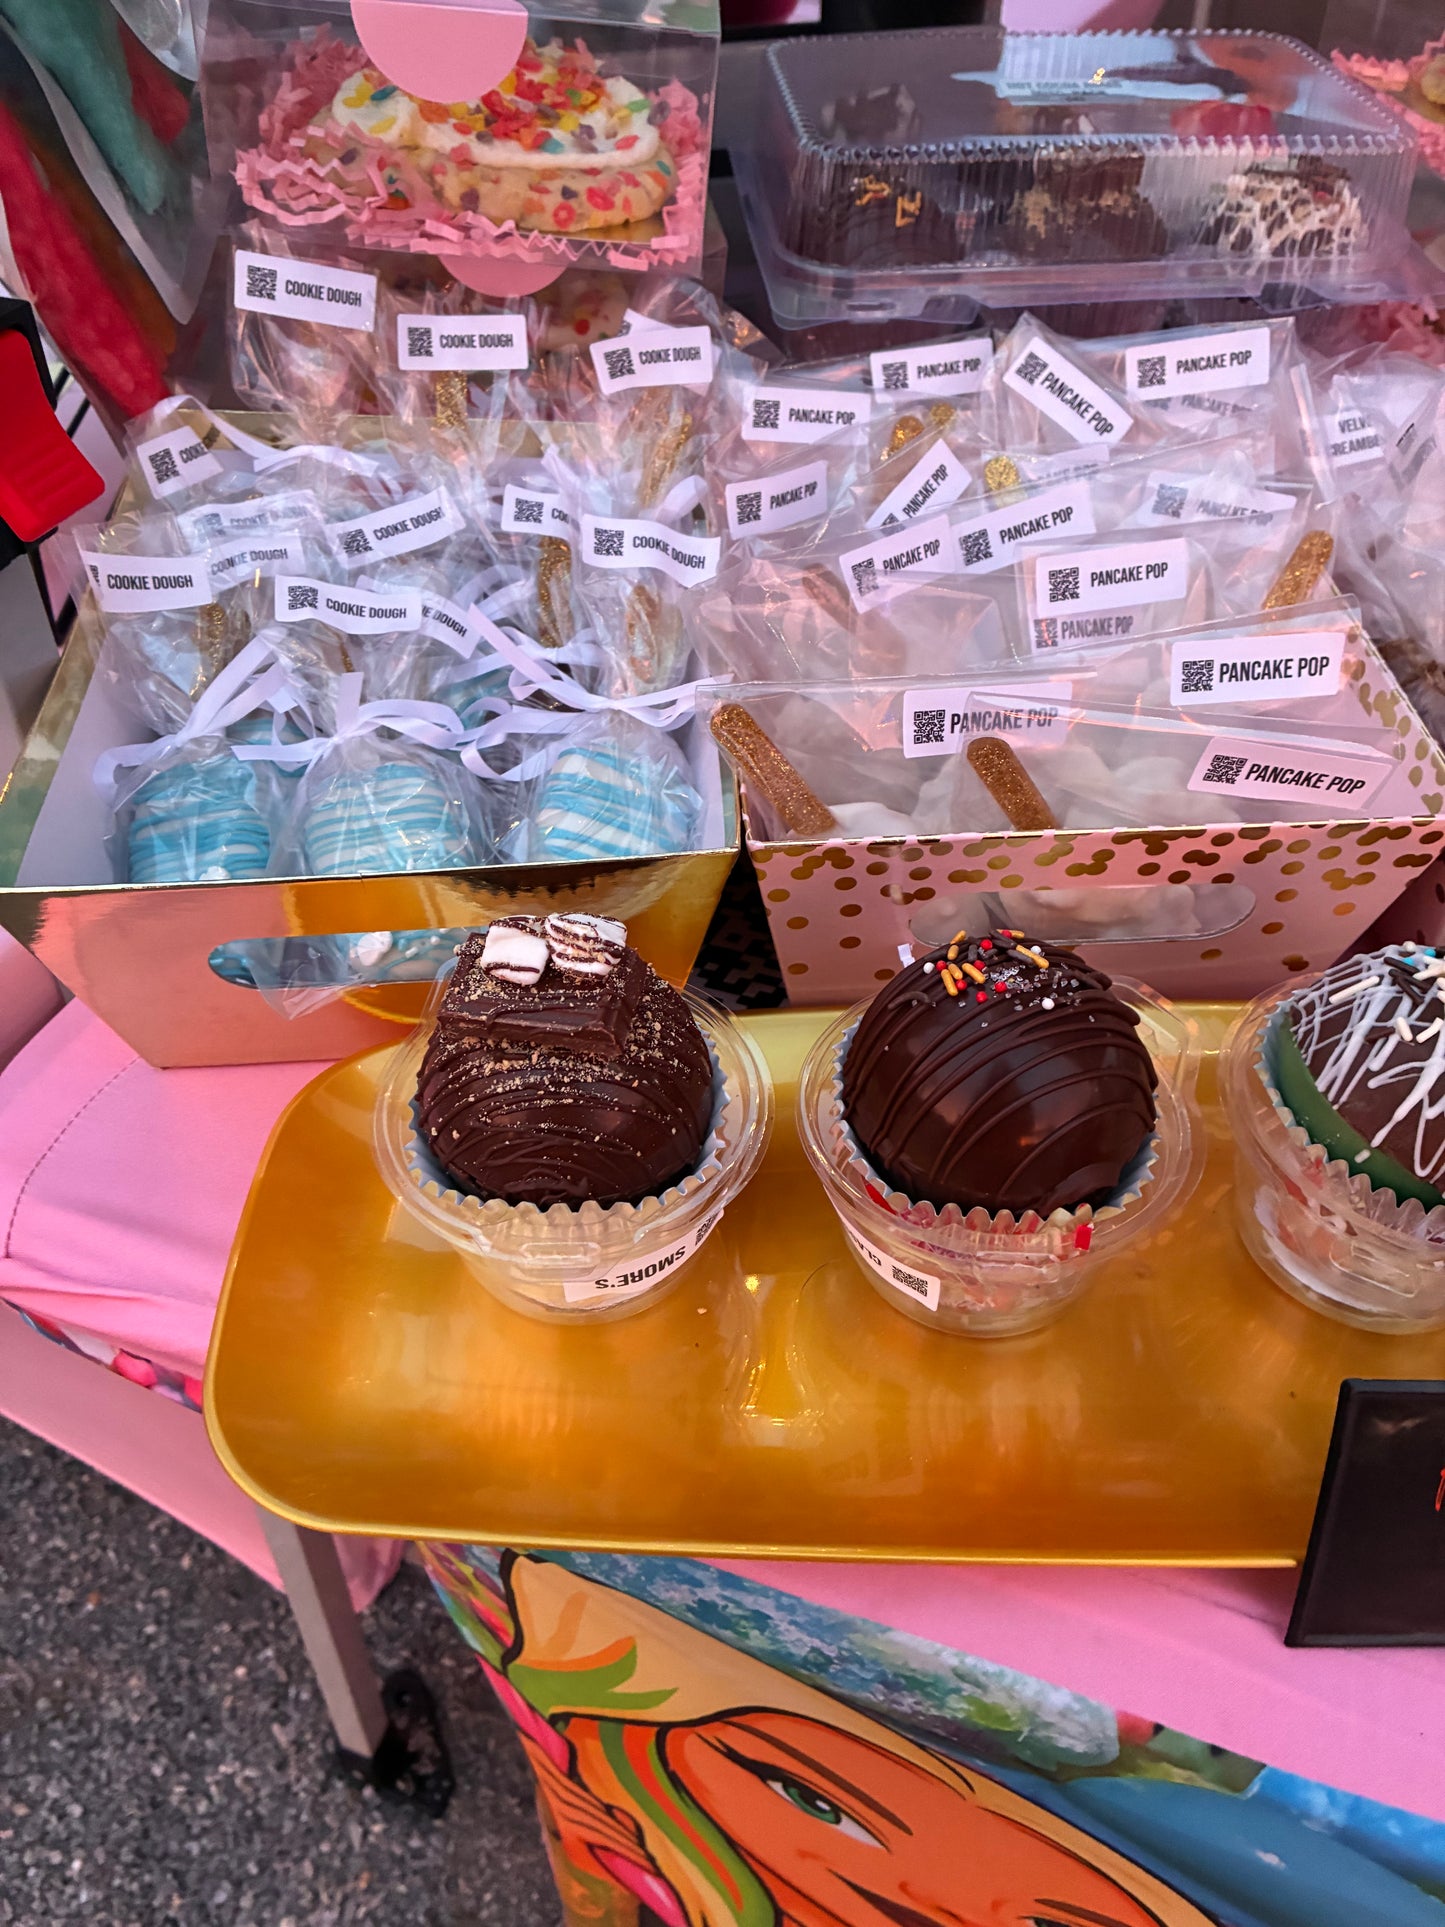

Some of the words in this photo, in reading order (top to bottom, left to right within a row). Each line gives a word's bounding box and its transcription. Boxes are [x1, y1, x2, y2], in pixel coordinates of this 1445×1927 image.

[285, 279, 324, 301] COOKIE
[326, 286, 362, 307] DOUGH
[439, 334, 477, 348] COOKIE
[479, 333, 513, 348] DOUGH
[638, 349, 671, 365] COOKIE
[673, 346, 702, 362] DOUGH
[916, 360, 962, 379] PANCAKE
[963, 357, 981, 373] POP
[1176, 353, 1228, 374] PANCAKE
[1229, 350, 1252, 367] POP
[788, 408, 834, 425] PANCAKE
[835, 410, 855, 425] POP
[1041, 371, 1094, 420] PANCAKE
[1088, 410, 1114, 437] POP
[769, 486, 803, 510] PANCAKE
[803, 480, 818, 498] POP
[902, 478, 940, 519] PANCAKE
[930, 463, 950, 486] POP
[372, 519, 412, 541] COOKIE
[410, 506, 445, 530] DOUGH
[999, 514, 1051, 545] PANCAKE
[1051, 506, 1073, 528] POP
[211, 552, 249, 575] COOKIE
[249, 548, 288, 562] DOUGH
[632, 535, 671, 557] COOKIE
[671, 547, 706, 570] DOUGH
[882, 545, 924, 576] PANCAKE
[923, 538, 941, 560] POP
[107, 574, 150, 590] COOKIE
[152, 574, 193, 590] DOUGH
[1090, 566, 1144, 588] PANCAKE
[1145, 562, 1169, 580] POP
[326, 598, 367, 618] COOKIE
[368, 607, 407, 619] DOUGH
[432, 609, 468, 637] DOUGH
[1060, 617, 1114, 640] PANCAKE
[1114, 615, 1134, 635] POP
[1219, 658, 1294, 684] PANCAKE
[1297, 656, 1331, 678] POP
[950, 709, 1023, 735] PANCAKE
[1027, 706, 1059, 730] POP
[1246, 762, 1326, 790] PANCAKE
[1327, 774, 1367, 797] POP
[594, 1245, 687, 1290] SMORE'S
